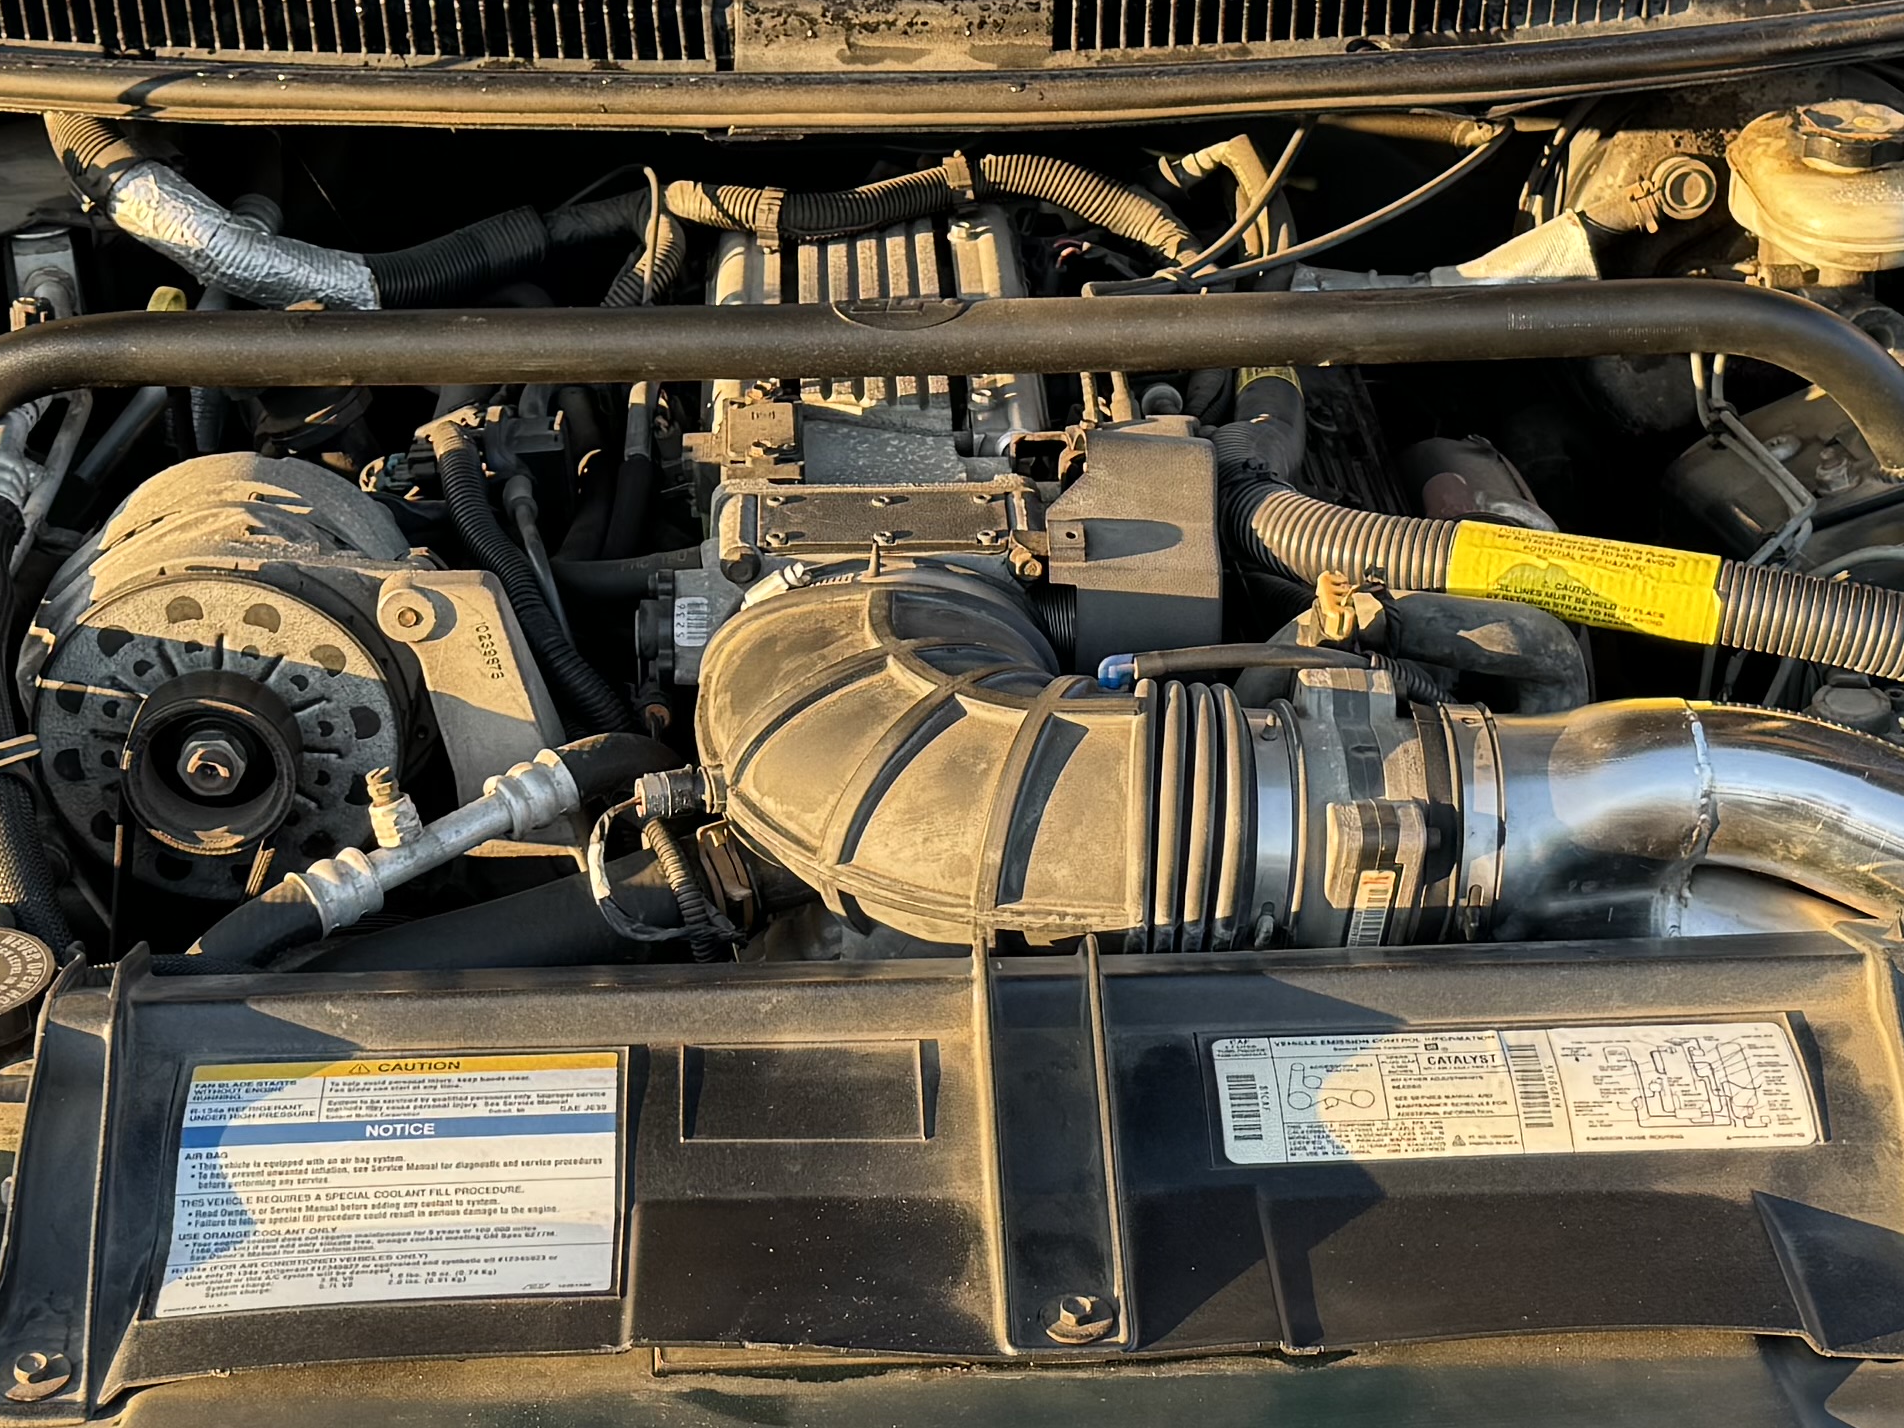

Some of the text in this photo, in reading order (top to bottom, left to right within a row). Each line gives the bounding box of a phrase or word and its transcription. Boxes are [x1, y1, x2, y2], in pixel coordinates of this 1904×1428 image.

[1546, 590, 1574, 603] MUST
[1427, 1054, 1498, 1065] CATALYST
[378, 1061, 461, 1072] CAUTION
[189, 1113, 227, 1122] UNDER
[258, 1109, 316, 1119] PRESSURE
[227, 1104, 303, 1114] REFRIGERANT
[365, 1123, 435, 1138] NOTICE
[205, 1152, 228, 1160] BAG
[198, 1163, 216, 1171] This
[263, 1159, 304, 1169] equipped
[306, 1158, 324, 1166] with
[231, 1170, 264, 1179] prevent
[267, 1167, 309, 1176] unwanted
[370, 1163, 403, 1172] Service
[406, 1163, 438, 1171] Manual
[455, 1160, 500, 1171] diagnostic
[521, 1159, 551, 1167] service
[554, 1158, 602, 1168] procedures
[207, 1197, 253, 1207] VEHICLE
[256, 1194, 311, 1205] REQUIRES
[325, 1191, 370, 1202] SPECIAL
[373, 1188, 426, 1199] COOLANT
[429, 1187, 451, 1196] FILL
[454, 1185, 524, 1196] PROCEDURE.
[195, 1210, 218, 1219] Read
[270, 1206, 303, 1215] Service
[305, 1204, 338, 1213] Manual
[195, 1218, 225, 1227] Failure
[268, 1215, 300, 1225] special
[317, 1212, 361, 1223] procedure
[463, 1207, 498, 1217] damage
[178, 1226, 337, 1241] USE ORANGE COOLANT ONLY
